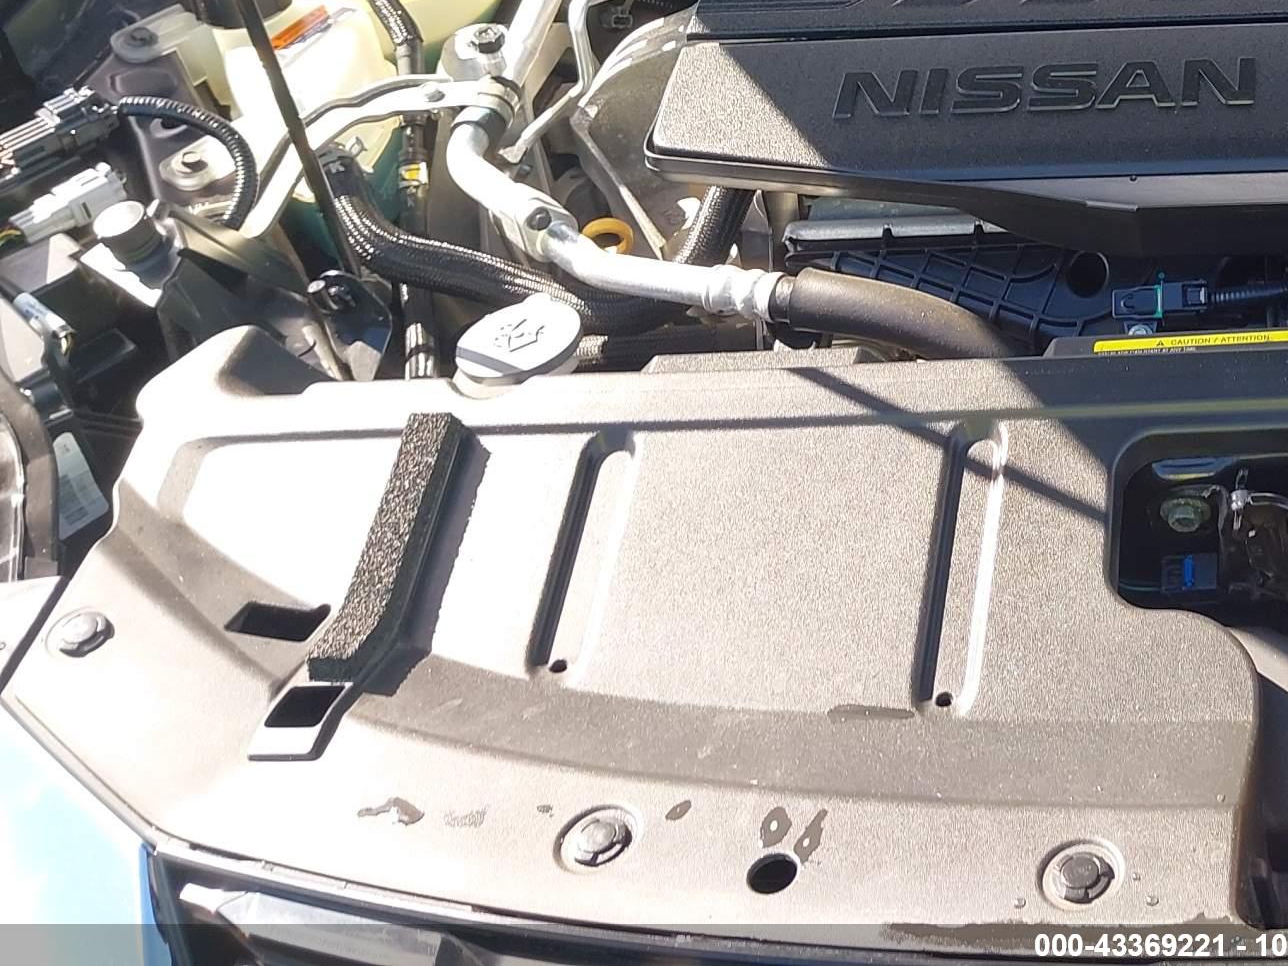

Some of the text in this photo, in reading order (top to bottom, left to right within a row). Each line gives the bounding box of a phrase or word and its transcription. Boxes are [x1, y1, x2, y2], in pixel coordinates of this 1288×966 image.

[832, 57, 1257, 119] NISSAN
[1170, 337, 1211, 346] CAUTION
[1220, 334, 1270, 343] ATTENTION
